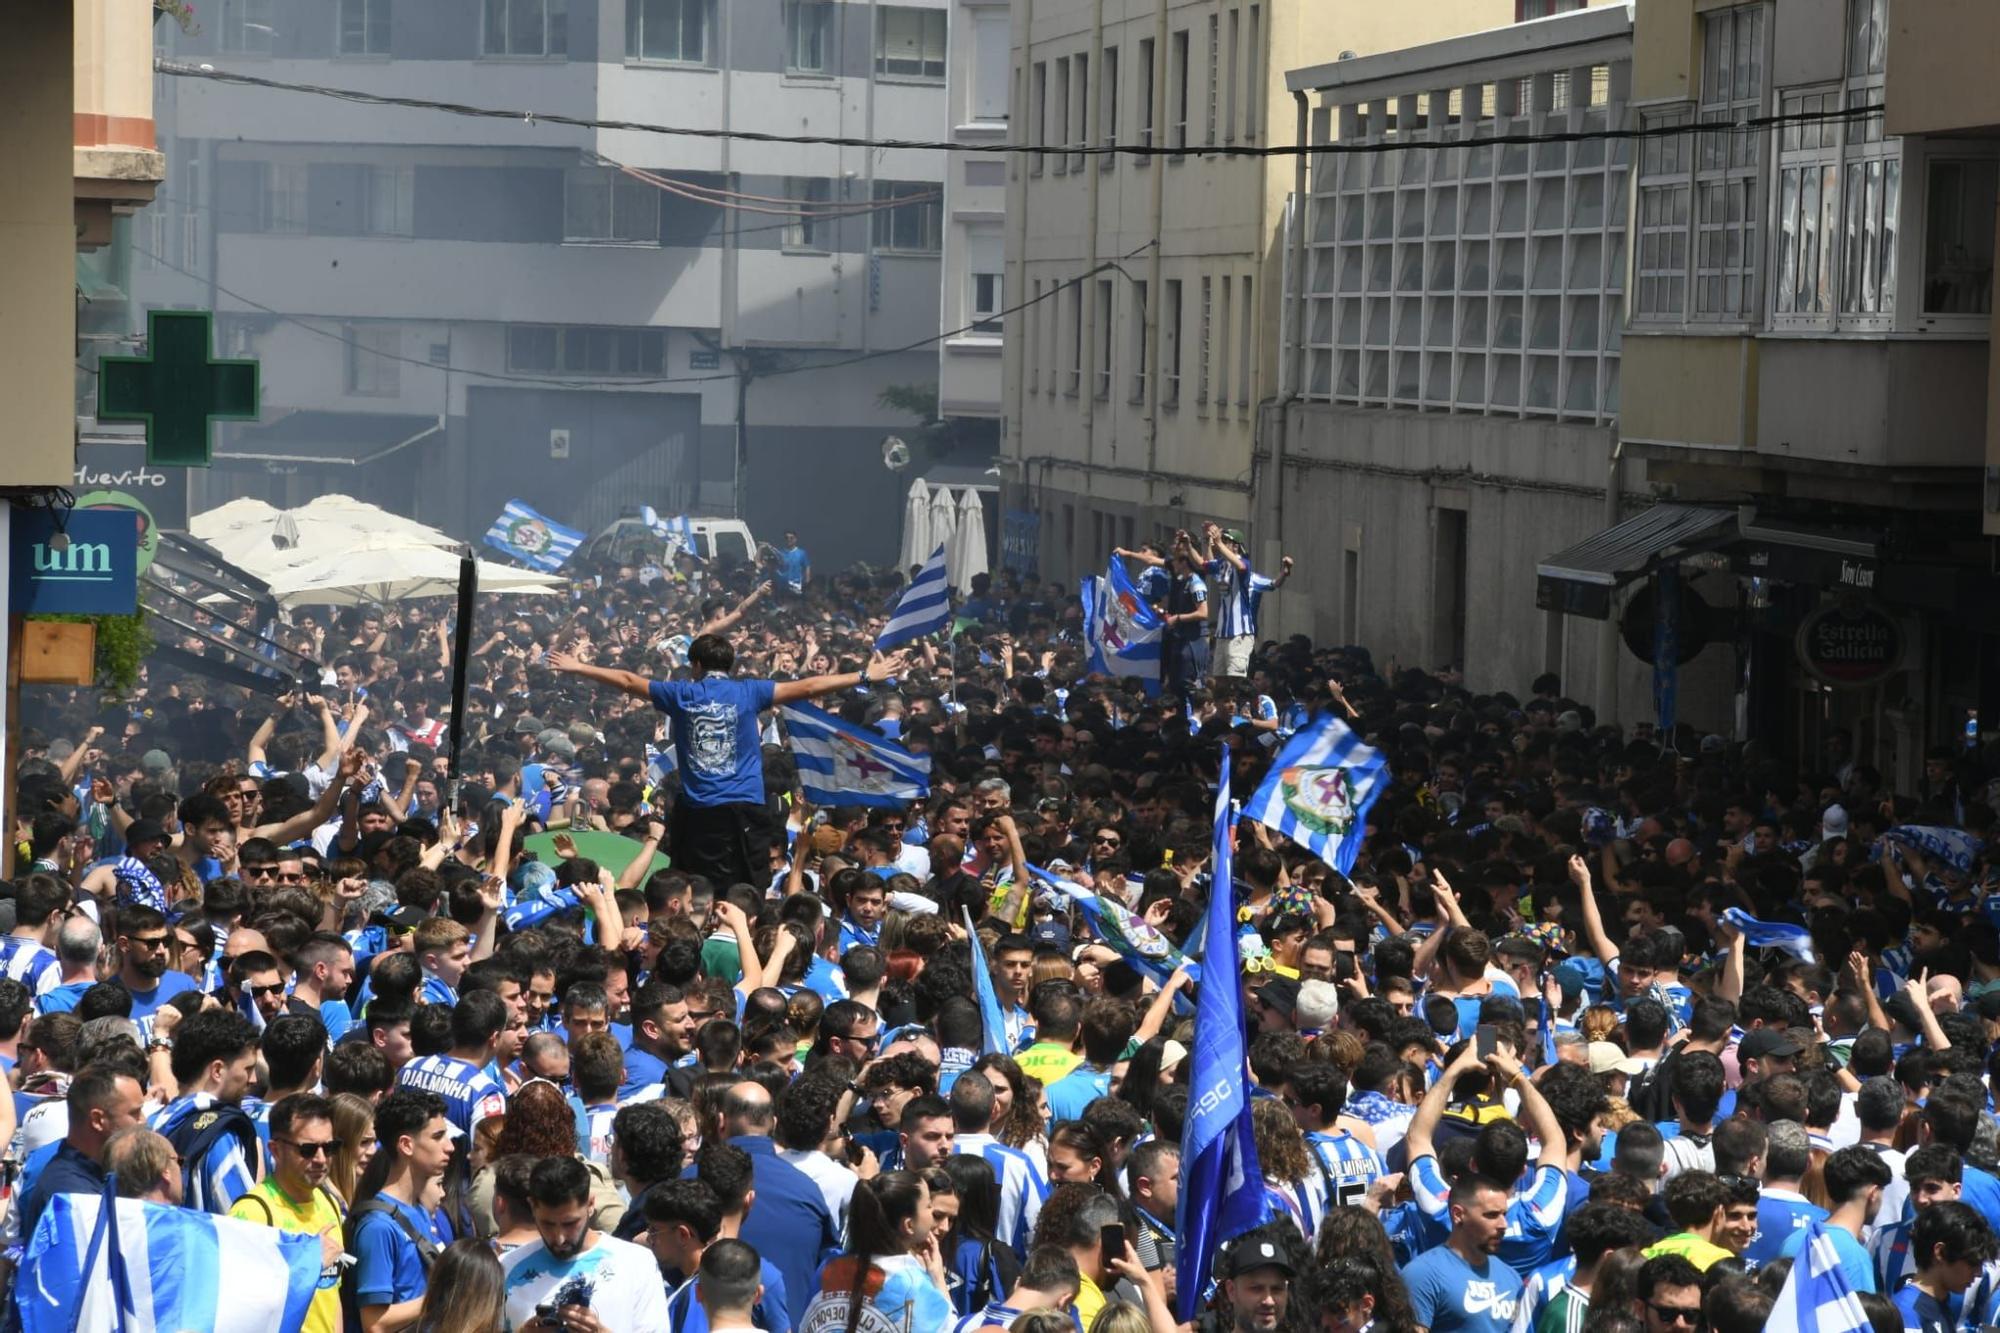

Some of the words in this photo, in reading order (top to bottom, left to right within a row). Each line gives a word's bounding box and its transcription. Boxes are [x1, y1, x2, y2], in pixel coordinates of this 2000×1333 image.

[32, 543, 112, 572] um
[1818, 624, 1888, 641] Estrella
[1820, 641, 1884, 658] Galicia
[402, 1069, 472, 1102] DJALMINHA
[1467, 1280, 1495, 1299] JUST
